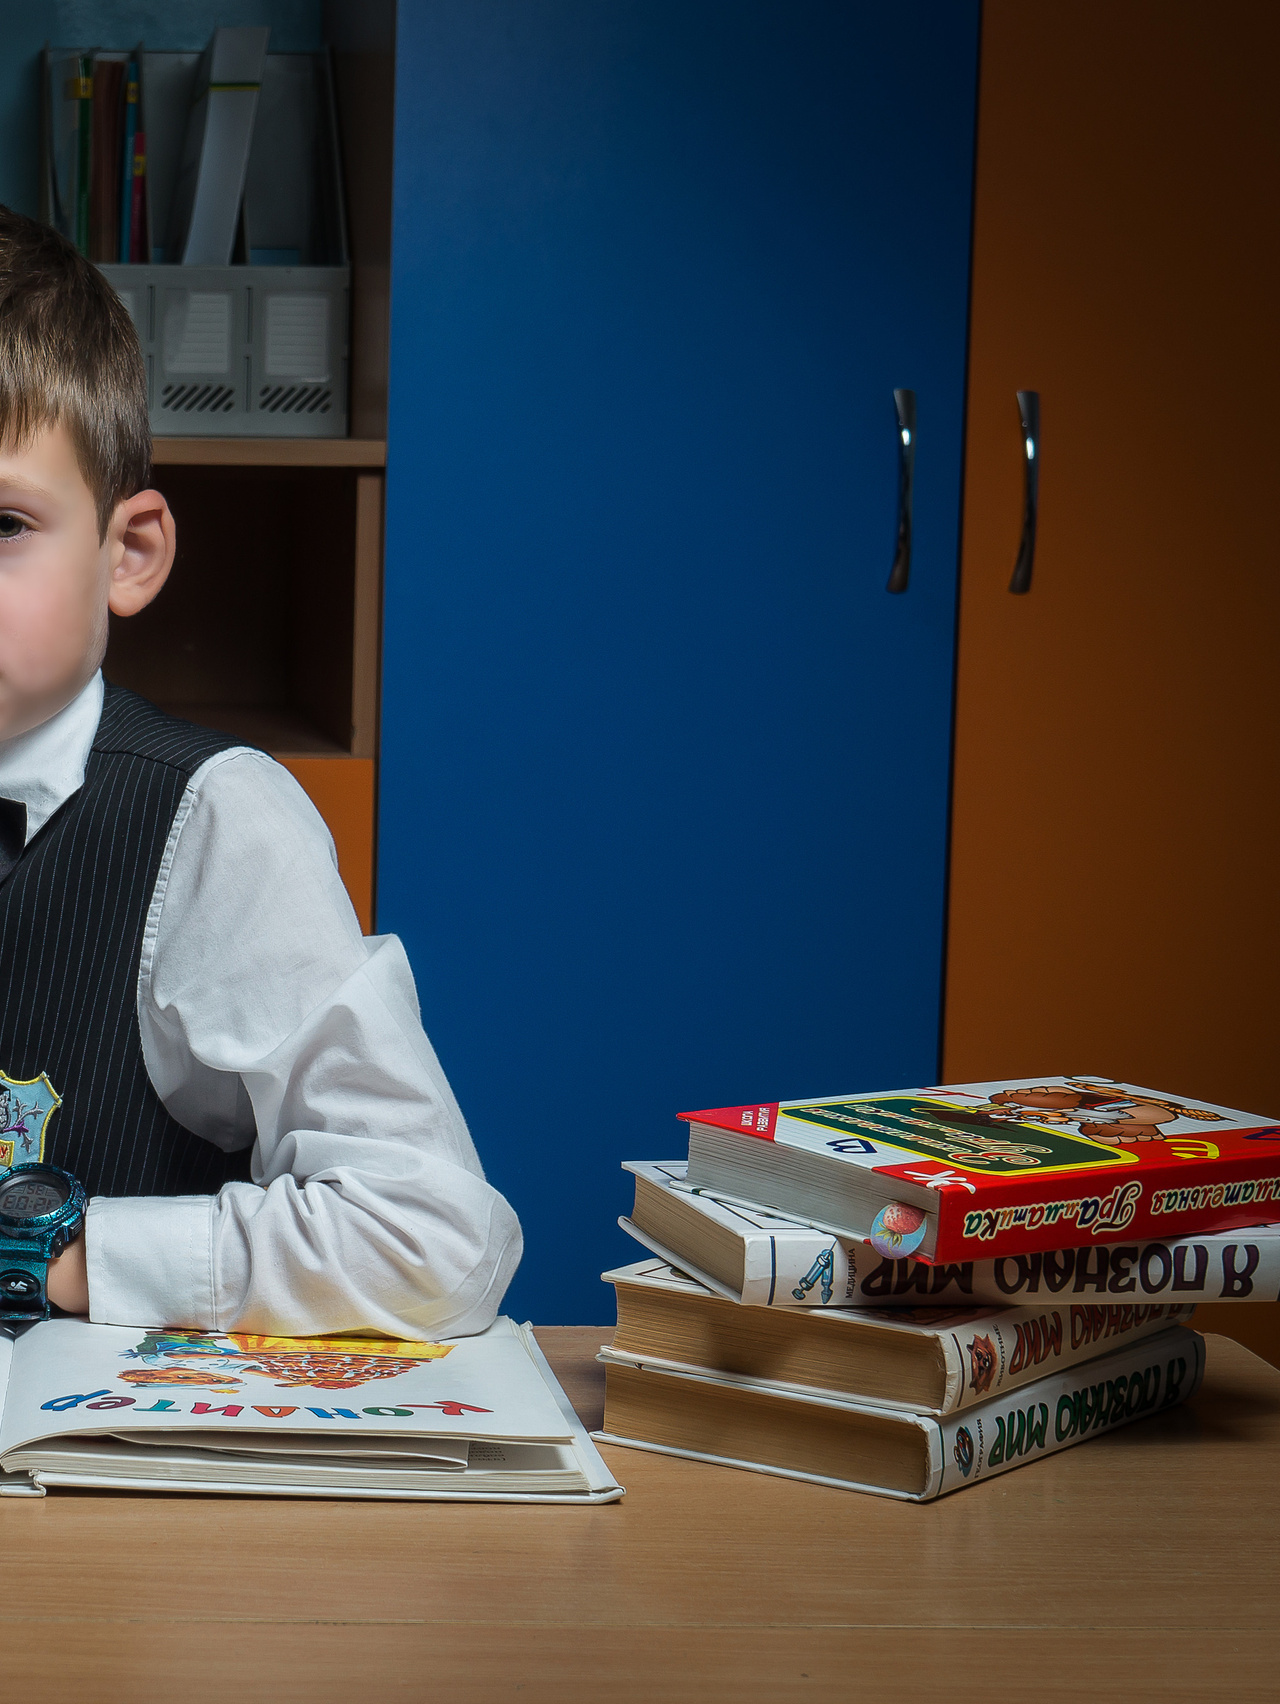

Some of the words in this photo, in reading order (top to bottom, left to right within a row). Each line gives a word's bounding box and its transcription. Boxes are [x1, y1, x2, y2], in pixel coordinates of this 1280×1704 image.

[963, 1180, 1144, 1242] Грамматика
[845, 1247, 858, 1299] МЕДИЦИНА
[860, 1255, 975, 1297] МИР
[993, 1244, 1210, 1296] ПОЗНАЮ
[1219, 1243, 1261, 1299] Я
[1008, 1310, 1063, 1376] МИР
[1054, 1364, 1162, 1443] ПОЗНАЮ
[1158, 1356, 1188, 1409] Я
[987, 1402, 1050, 1468] МИР
